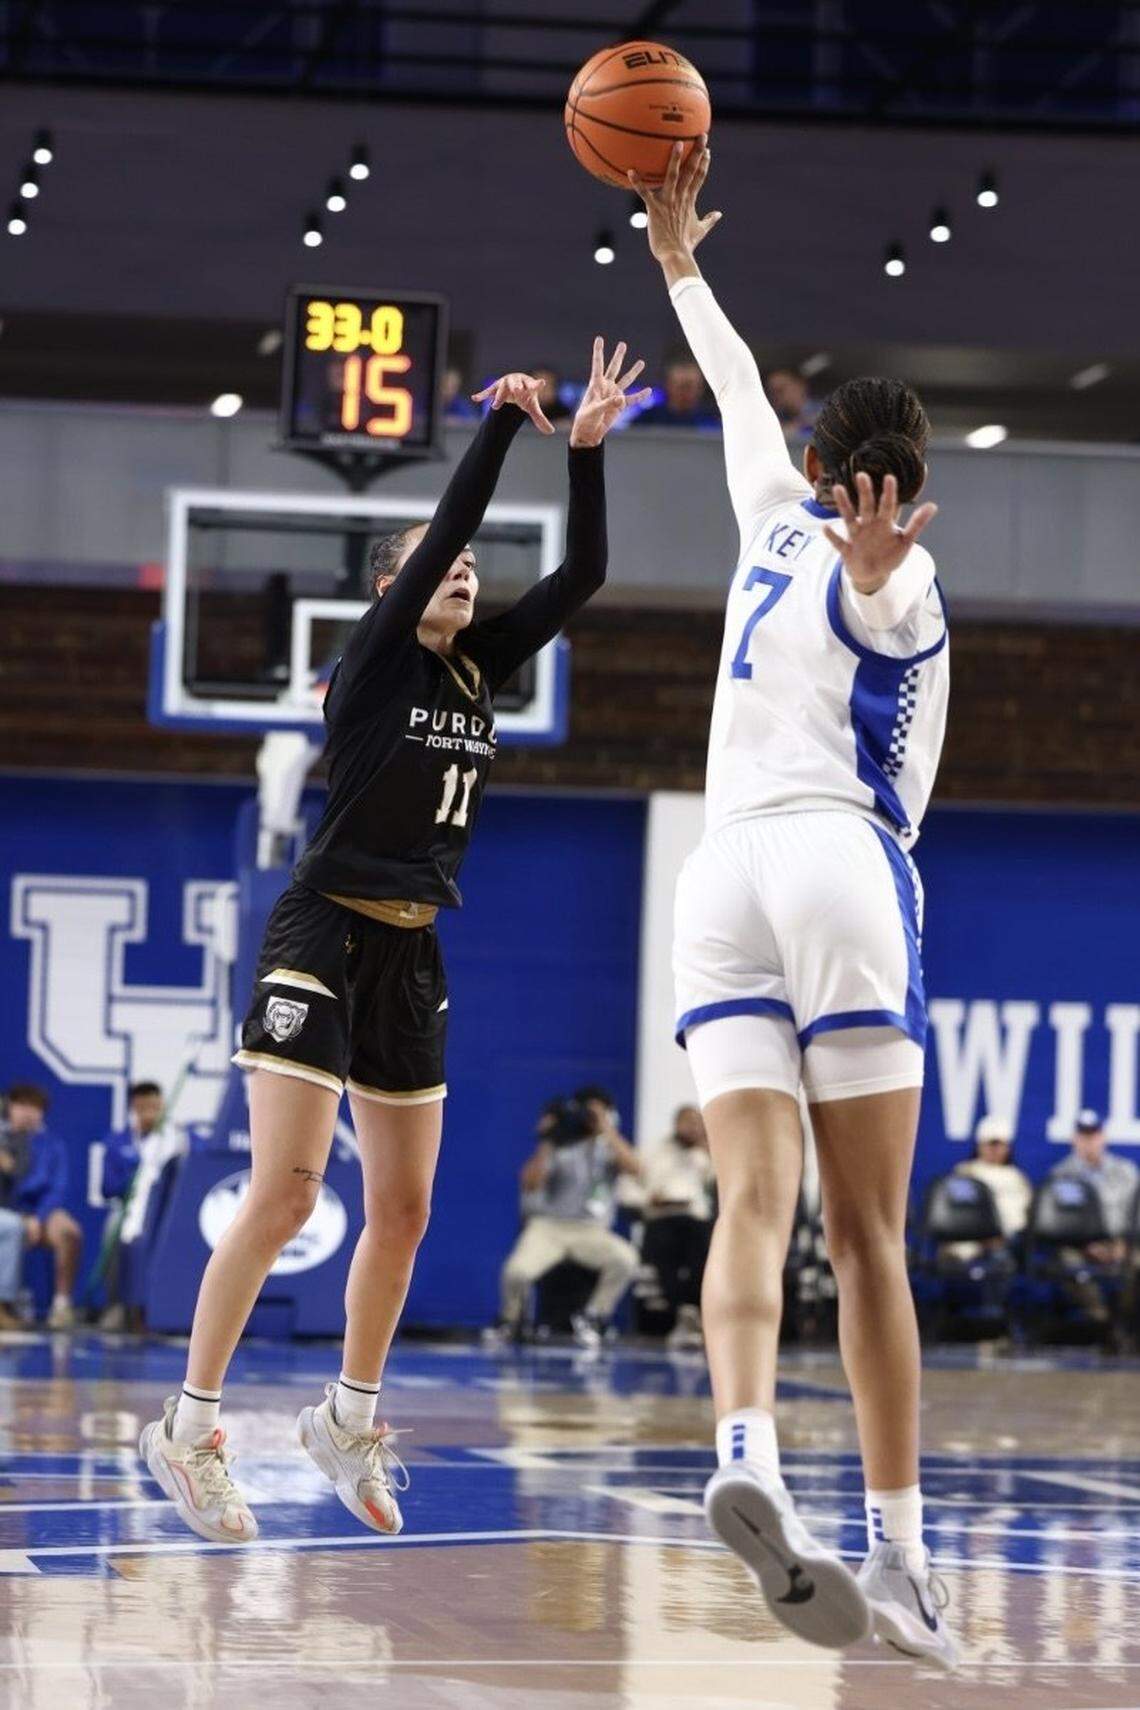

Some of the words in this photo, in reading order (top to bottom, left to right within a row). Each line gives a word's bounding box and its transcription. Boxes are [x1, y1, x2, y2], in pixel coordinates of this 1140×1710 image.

[622, 51, 684, 70] ELIT
[341, 354, 413, 437] 15
[731, 566, 793, 680] 7
[435, 764, 477, 827] 11
